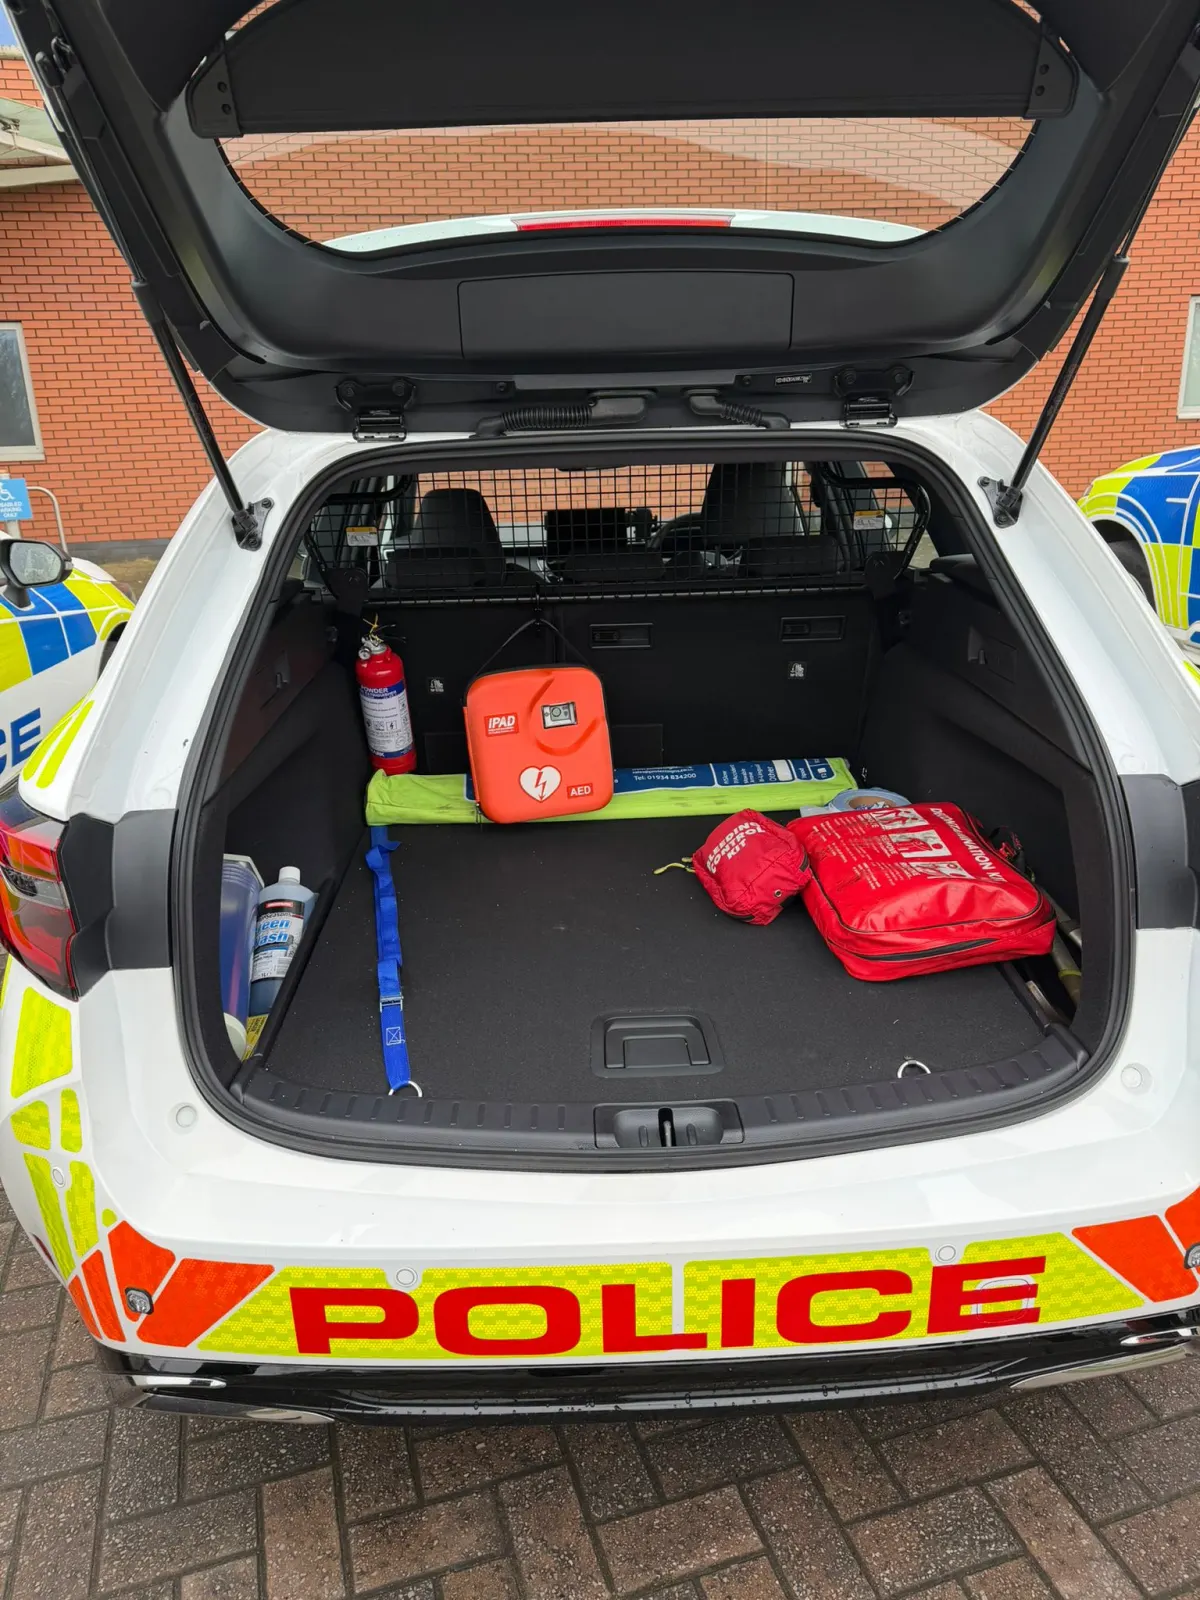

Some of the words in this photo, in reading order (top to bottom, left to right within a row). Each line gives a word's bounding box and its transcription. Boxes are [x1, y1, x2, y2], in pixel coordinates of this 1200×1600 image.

[0, 707, 42, 775] E
[670, 772, 697, 780] 834200
[767, 766, 777, 781] Other
[570, 785, 592, 797] AED
[710, 827, 766, 874] CONTROL
[727, 838, 746, 860] KIT
[256, 931, 288, 946] ash
[290, 1255, 1046, 1356] POLICE
